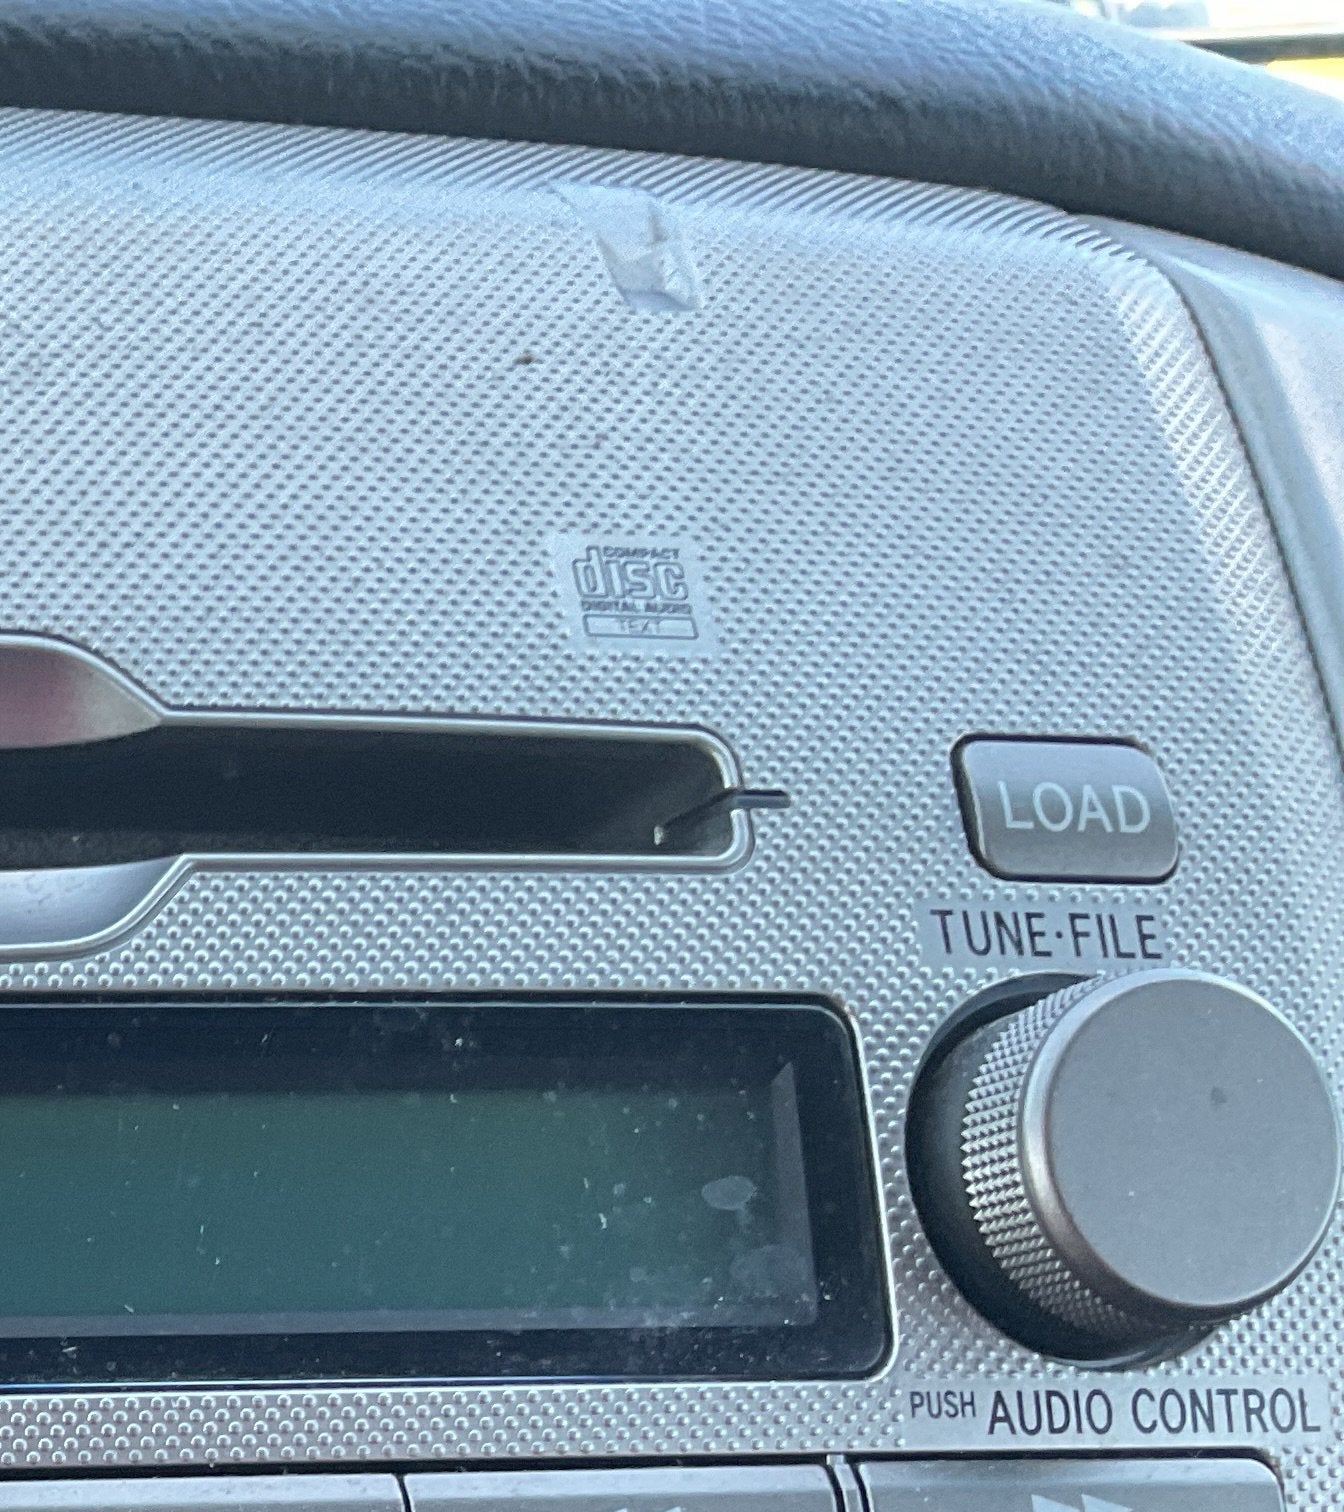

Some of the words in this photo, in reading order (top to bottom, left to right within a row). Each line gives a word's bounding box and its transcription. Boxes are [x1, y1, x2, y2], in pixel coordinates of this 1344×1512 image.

[998, 781, 1150, 835] LOAD
[911, 1390, 976, 1419] PUSH
[987, 1387, 1113, 1436] AUDIO
[1131, 1386, 1321, 1435] CONTROL
